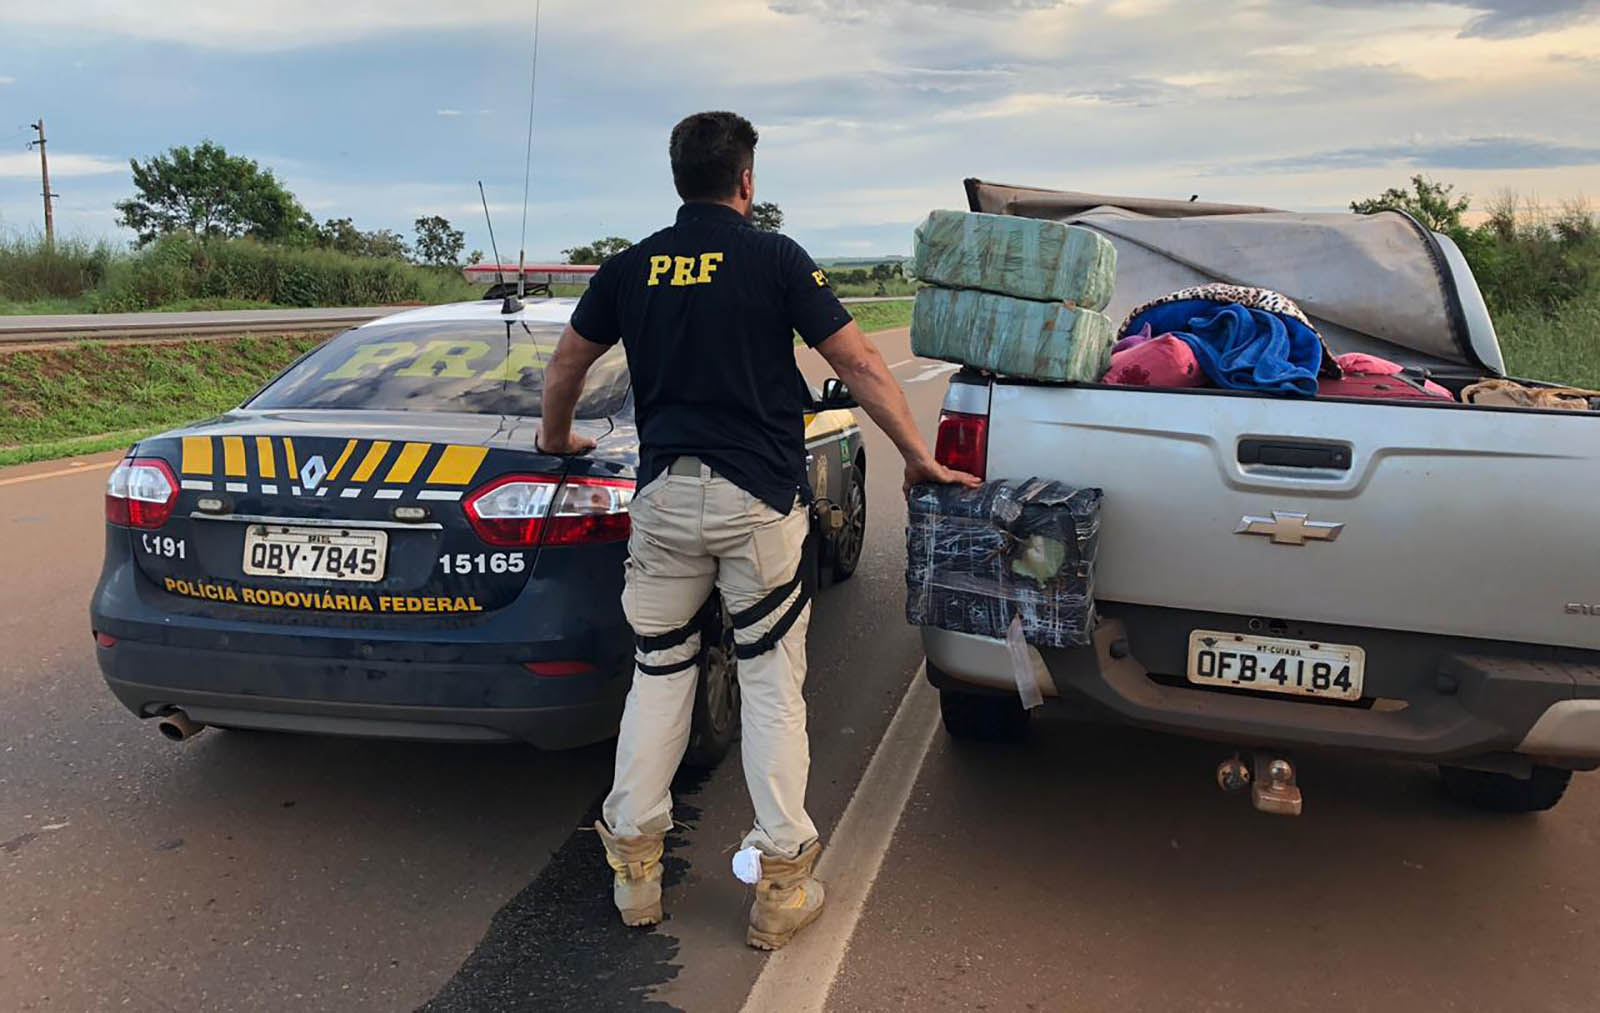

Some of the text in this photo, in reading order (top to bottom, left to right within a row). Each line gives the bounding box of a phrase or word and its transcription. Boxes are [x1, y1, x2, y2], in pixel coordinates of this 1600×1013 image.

[647, 252, 724, 286] PRF
[321, 340, 557, 382] PRF
[152, 536, 186, 559] 191
[439, 552, 525, 574] 15165
[164, 577, 483, 612] POLÍCIA RODOVIÁRIA FEDERAL
